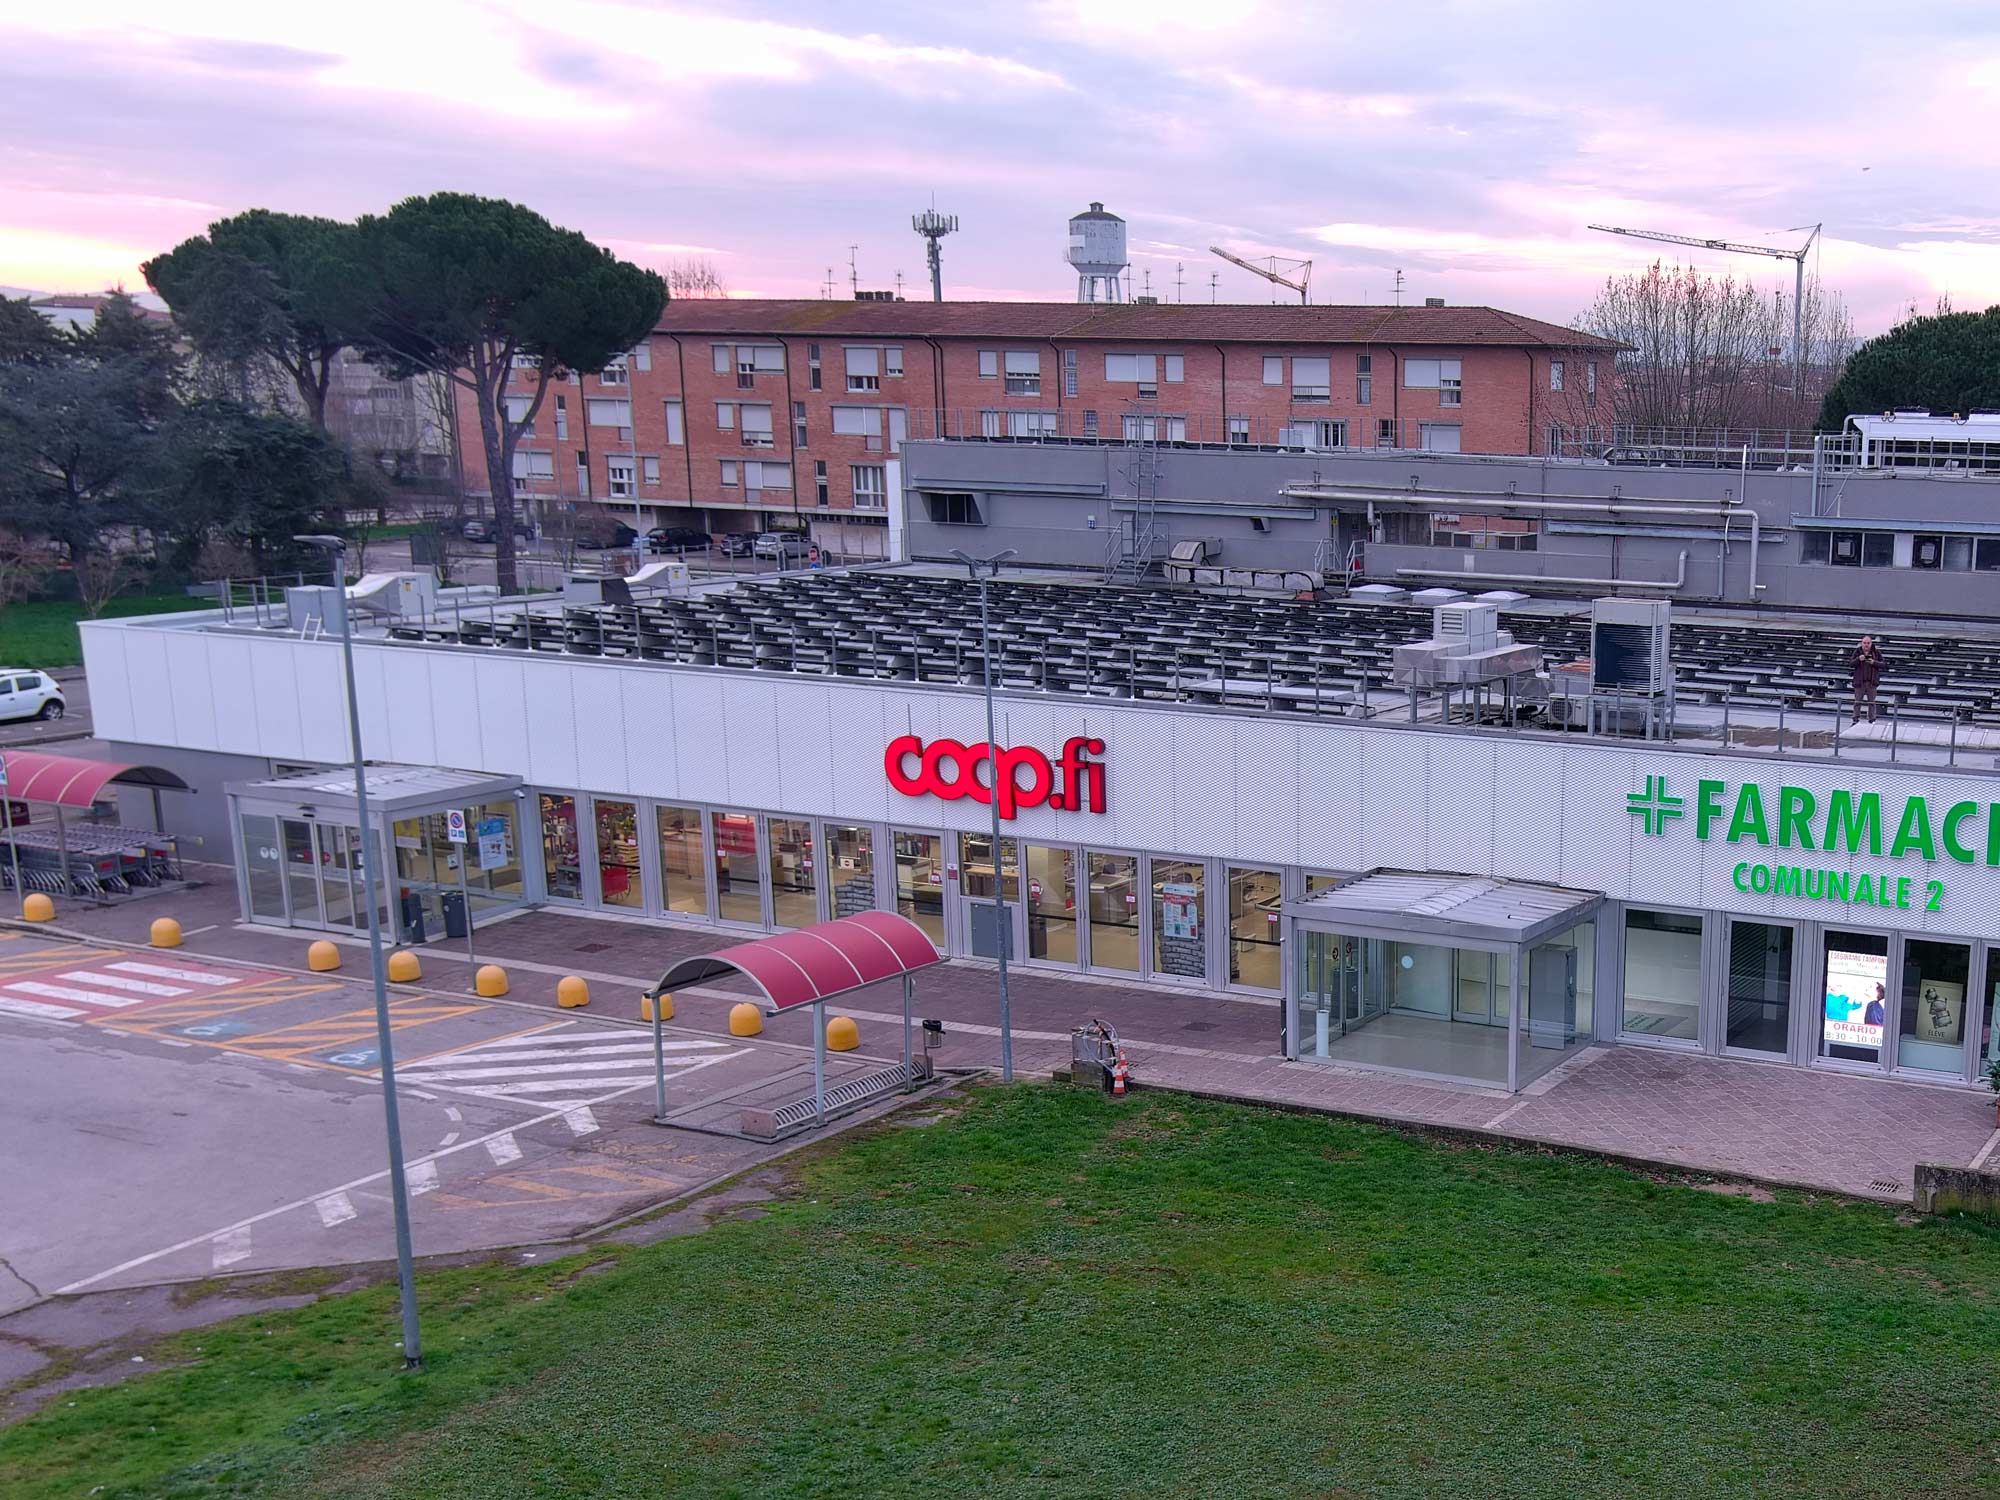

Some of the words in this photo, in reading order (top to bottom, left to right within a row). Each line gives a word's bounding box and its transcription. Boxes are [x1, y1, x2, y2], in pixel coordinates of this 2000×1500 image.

[884, 735, 1106, 820] coop.fi
[1732, 862, 1912, 908] COMUNALE
[1925, 880, 1945, 911] 2
[1833, 1022, 1877, 1035] ORARIO
